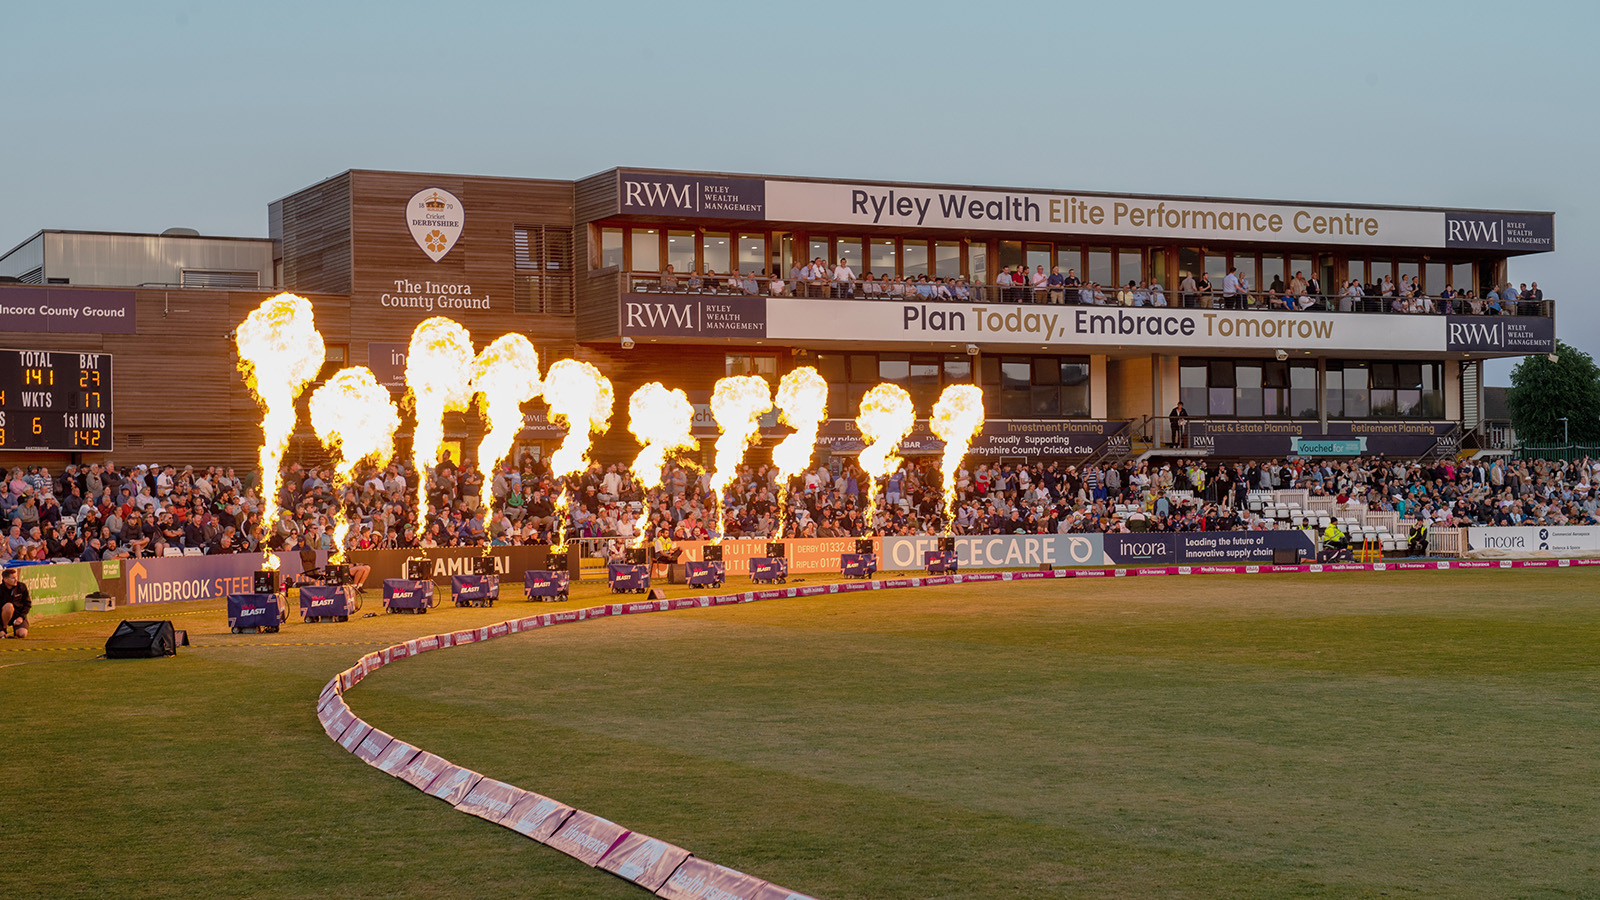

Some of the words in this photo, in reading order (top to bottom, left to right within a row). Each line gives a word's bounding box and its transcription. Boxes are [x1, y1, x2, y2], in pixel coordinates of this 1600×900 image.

[624, 181, 692, 209] RWM
[704, 185, 730, 193] RYLEY
[704, 194, 739, 202] WEALTH
[704, 203, 762, 212] MANAGEMENT
[851, 189, 932, 226] Ryley
[938, 193, 1040, 223] Wealth
[1048, 197, 1105, 226] Elite
[1113, 202, 1283, 234] Performance
[1293, 210, 1379, 237] Centre
[1448, 219, 1498, 242] RWM
[394, 279, 422, 294] The
[425, 281, 472, 295] Incora
[381, 293, 434, 311] County
[437, 295, 490, 309] Ground
[39, 305, 79, 318] County
[82, 306, 125, 317] Ground
[625, 302, 694, 329] RWM
[706, 322, 764, 330] MANAGEMENT
[903, 305, 966, 332] Plan
[972, 307, 1064, 342] Today,
[1075, 310, 1196, 336] Embrace
[1203, 313, 1334, 340] Tomorrow
[1449, 323, 1500, 345] RWM
[20, 352, 52, 368] TOTAL
[80, 354, 100, 370] BAT
[26, 369, 54, 386] 141
[22, 391, 52, 408] WKTS
[63, 412, 78, 428] 1st
[82, 413, 106, 428] INNS
[32, 417, 42, 434] 6
[74, 430, 100, 446] 142
[1007, 423, 1061, 432] Investment
[1063, 423, 1104, 434] Planning
[1226, 424, 1234, 432] &
[1236, 424, 1262, 432] Estate
[1264, 424, 1302, 435] Planning
[1350, 424, 1398, 432] Retirement
[1398, 424, 1435, 435] Planning
[990, 435, 1021, 446] Proudly
[1024, 436, 1070, 446] Supporting
[1193, 436, 1214, 446] RWM
[1011, 446, 1042, 456] County
[1043, 446, 1072, 454] Cricket
[1075, 446, 1093, 454] Club
[798, 545, 819, 553] DERBY
[820, 542, 845, 552] 01332
[1120, 540, 1166, 556] incora
[1186, 538, 1217, 548] Leading
[1218, 537, 1231, 546] the
[1232, 537, 1254, 546] future
[1255, 536, 1264, 545] of
[1484, 533, 1525, 548] incora
[1186, 549, 1225, 558] innovative
[1226, 548, 1251, 559] supply
[1252, 548, 1273, 556] chain
[430, 556, 510, 577] AMUAI
[138, 579, 210, 603] MIDBROOK
[669, 867, 706, 894] Health
